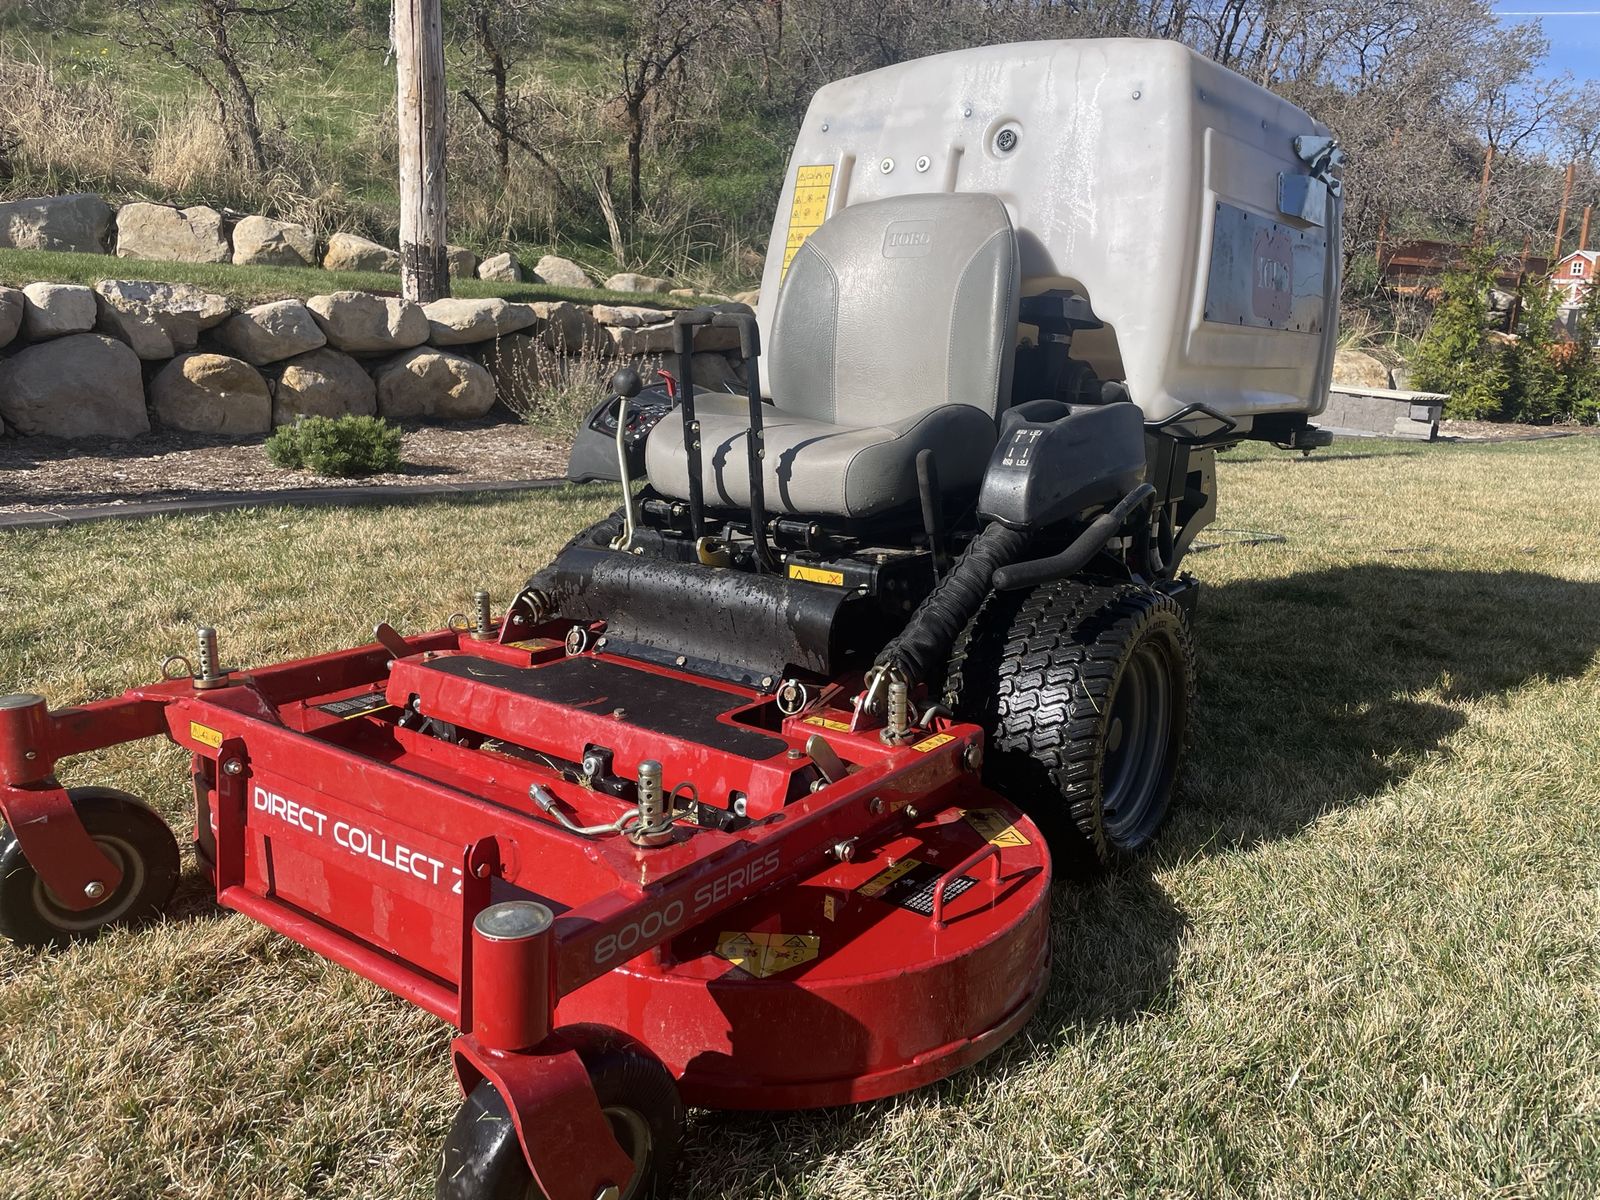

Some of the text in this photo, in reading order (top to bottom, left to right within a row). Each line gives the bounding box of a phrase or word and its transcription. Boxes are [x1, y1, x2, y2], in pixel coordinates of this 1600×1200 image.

[889, 232, 930, 247] TORO
[254, 786, 328, 836] DIRECT
[333, 821, 445, 885] COLLECT
[594, 900, 685, 965] 8000
[694, 849, 781, 913] SERIES
